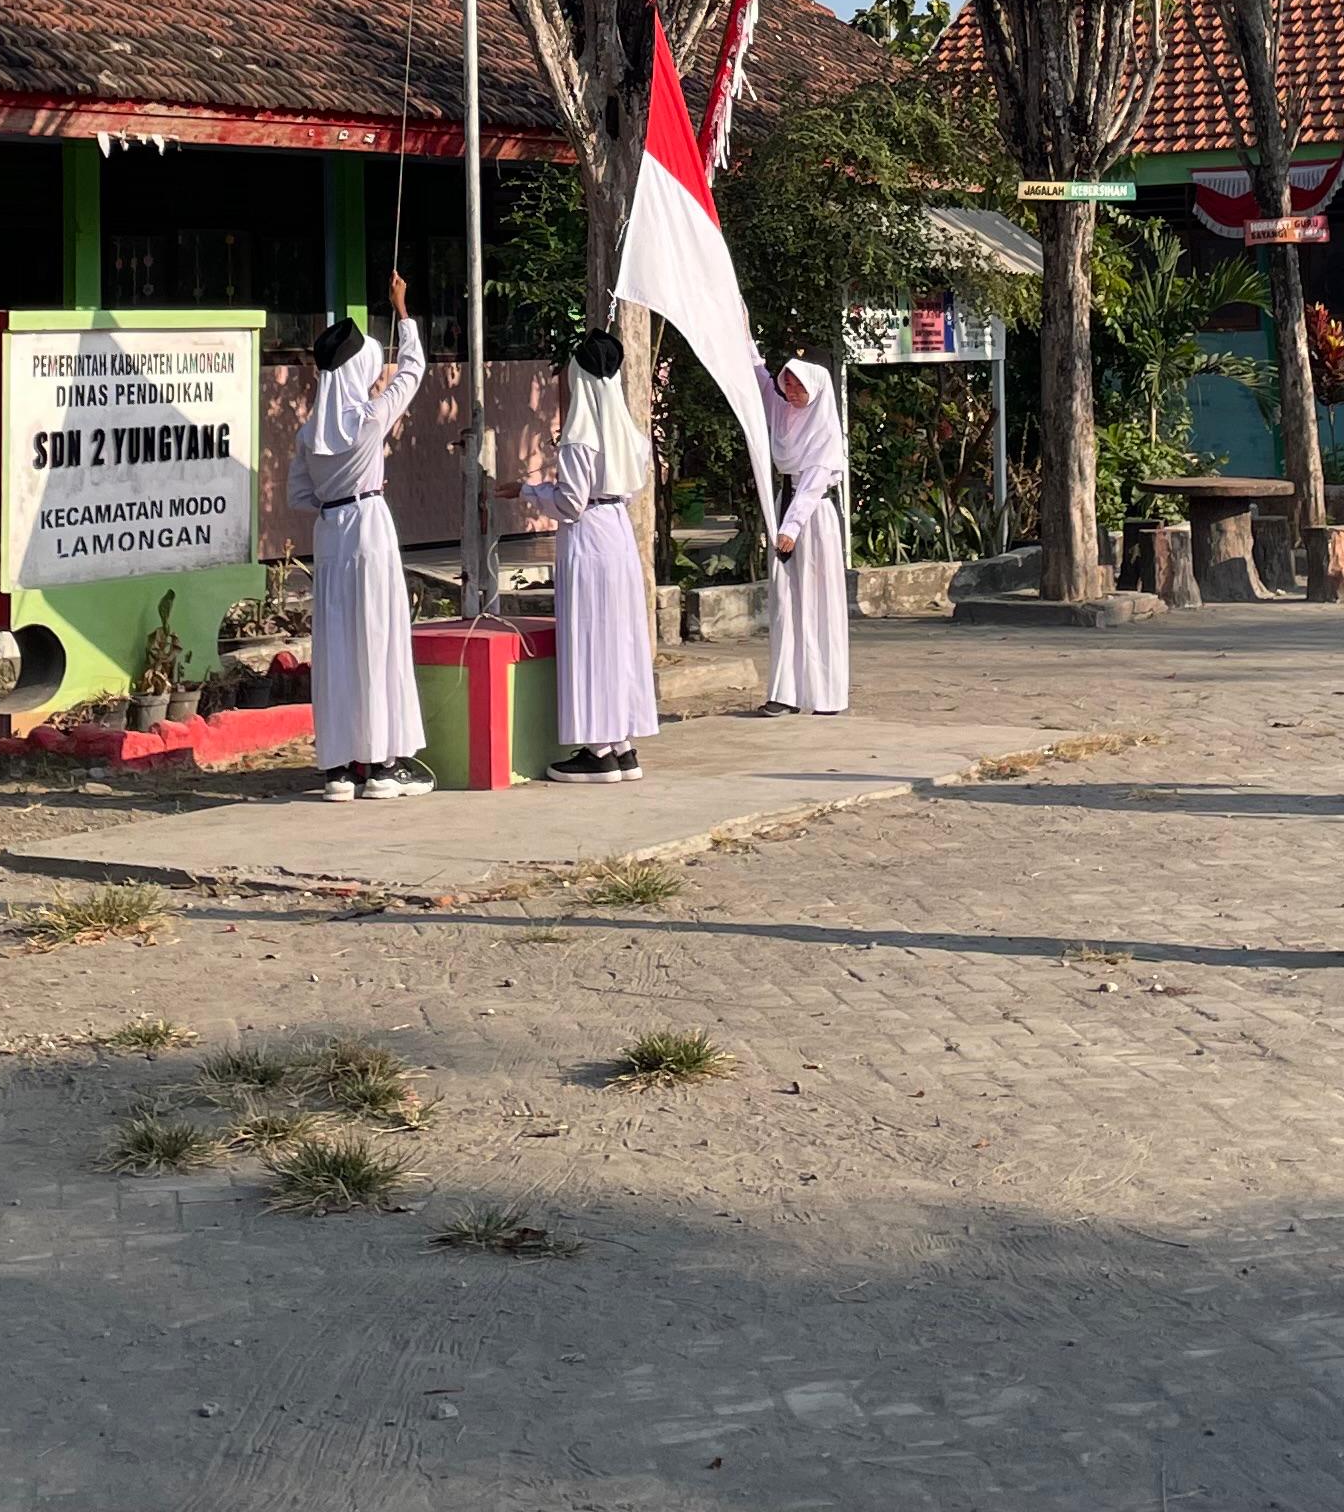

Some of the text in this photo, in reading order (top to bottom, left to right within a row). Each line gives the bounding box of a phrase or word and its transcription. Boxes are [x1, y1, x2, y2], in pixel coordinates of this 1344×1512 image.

[1024, 184, 1127, 196] JAGALAH KEBERSIHAN
[33, 351, 235, 377] PEMERINTAH KABUPATEN LAMONGAN
[56, 382, 214, 407] DINAS PENDIDIKAN
[32, 422, 230, 469] SDN 2 YUNGYANG
[41, 495, 226, 530] KECAMATAN MODO
[57, 525, 211, 558] LAMONGAN
